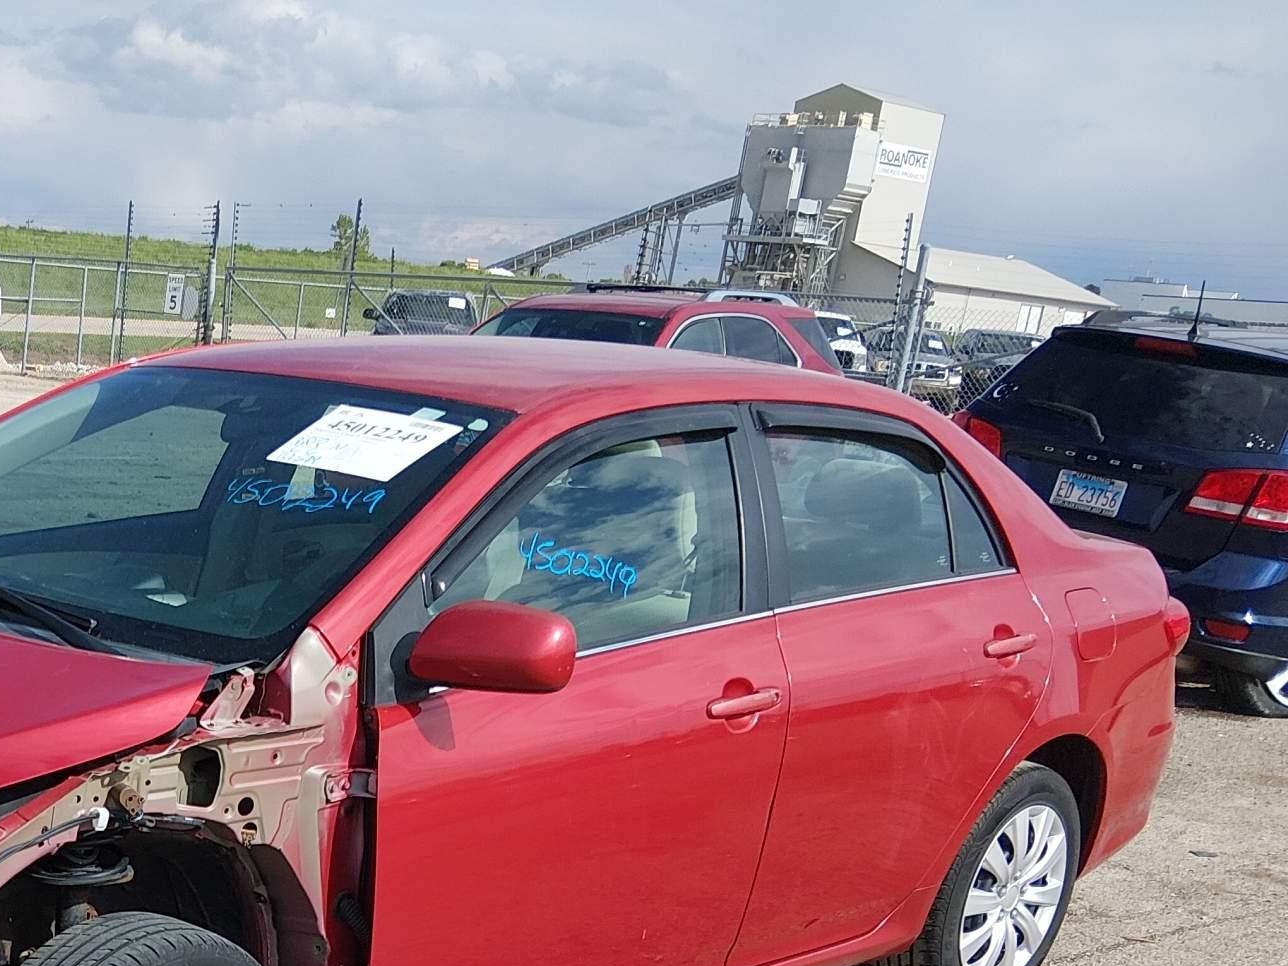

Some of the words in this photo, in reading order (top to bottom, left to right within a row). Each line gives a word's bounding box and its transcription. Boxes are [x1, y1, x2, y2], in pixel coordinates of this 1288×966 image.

[879, 148, 929, 169] ROANOKE
[169, 295, 177, 310] 5
[328, 419, 428, 443] 45012249
[1044, 446, 1144, 470] DODGE
[1056, 480, 1075, 499] ED
[1078, 485, 1120, 509] 23756
[520, 531, 638, 599] 45012249
